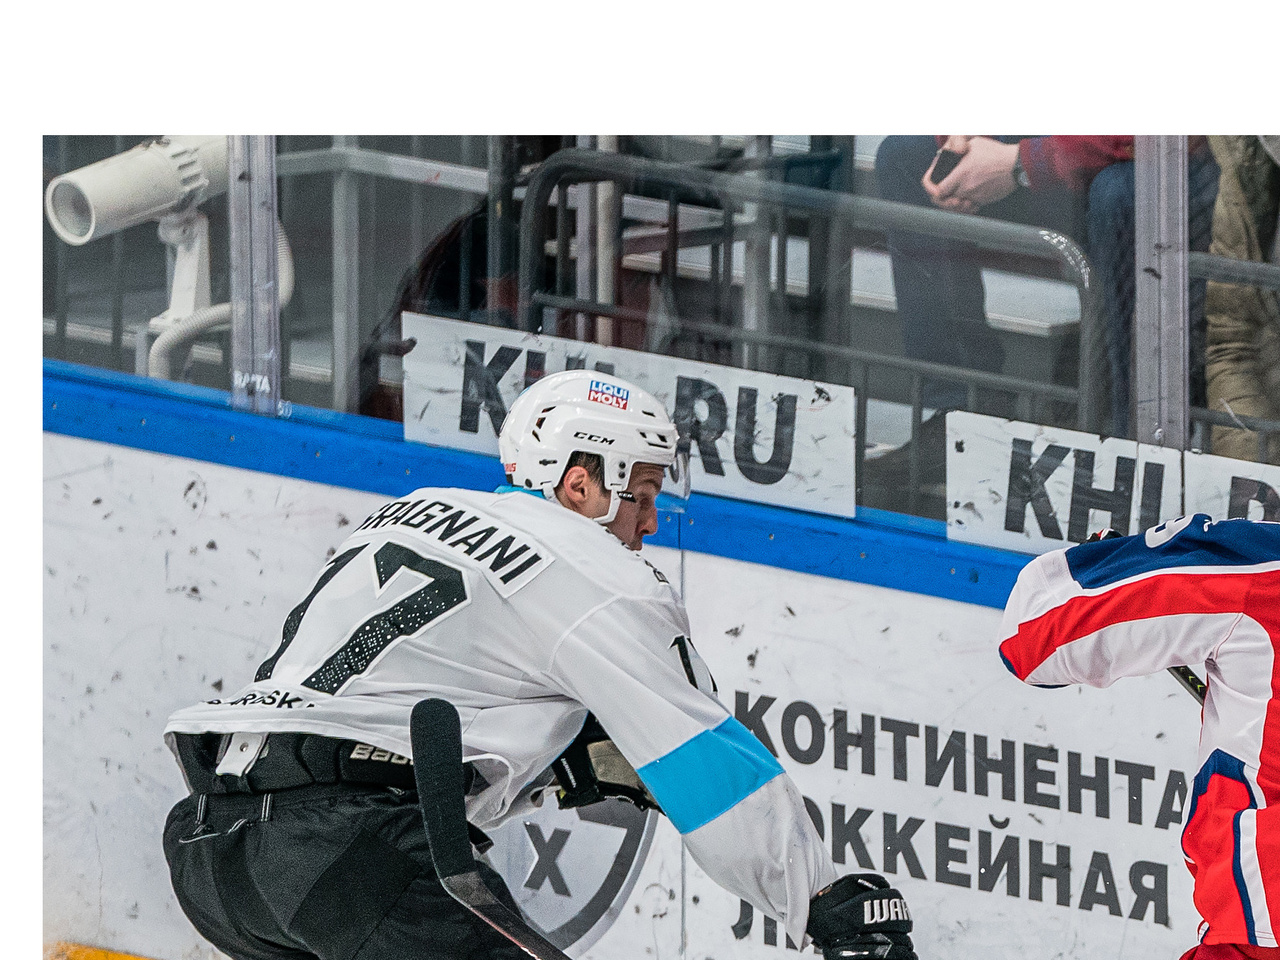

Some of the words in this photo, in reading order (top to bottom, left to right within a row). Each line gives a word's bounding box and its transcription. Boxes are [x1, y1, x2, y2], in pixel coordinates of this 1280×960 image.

[591, 380, 630, 399] LIQUI
[589, 391, 628, 410] MOLY
[573, 431, 616, 446] CCM
